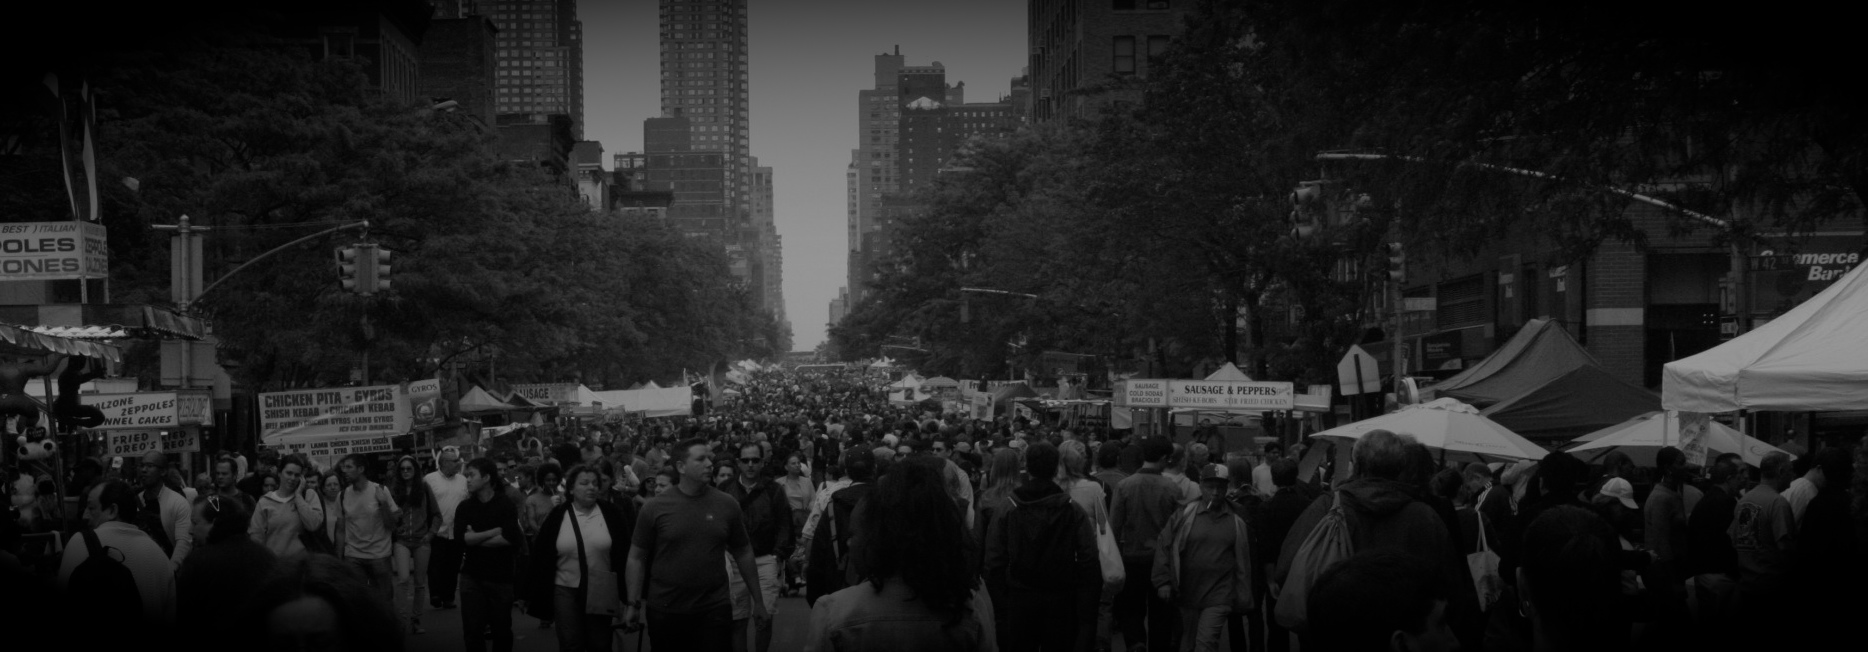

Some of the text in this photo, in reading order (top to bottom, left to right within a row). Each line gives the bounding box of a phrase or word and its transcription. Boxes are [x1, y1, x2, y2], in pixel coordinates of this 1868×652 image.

[2, 225, 29, 234] BEST
[39, 224, 77, 233] ITALIAN
[0, 237, 76, 254] OLES
[1760, 249, 1860, 265] mmerce
[1762, 256, 1777, 270] 42
[0, 257, 80, 274] ONES
[411, 383, 438, 393] GYROS
[517, 387, 549, 399] USAGE
[1184, 384, 1224, 395] SAUSAGE
[1227, 385, 1234, 395] &
[1237, 386, 1277, 396] PEPPERS
[91, 397, 134, 410] ALZONE
[264, 389, 393, 408] CHICKEN PITA GYROS
[121, 399, 175, 416] ZEPPOLES
[264, 408, 290, 419] SHISH
[292, 407, 320, 418] KEBAB
[368, 402, 395, 413] KEBAB
[103, 415, 173, 426] NNEL CAKES
[330, 417, 351, 425] GYROS
[355, 416, 372, 424] LAMB
[373, 415, 394, 423] GYROS
[113, 433, 149, 445] FRIED
[161, 430, 187, 442] RIED
[115, 441, 157, 454] OREO'S
[163, 438, 194, 450] REO'S
[310, 441, 329, 449] LAMB
[329, 440, 350, 448] CHICKEN
[351, 445, 373, 453] KEBAB
[333, 447, 348, 455] GYRO
